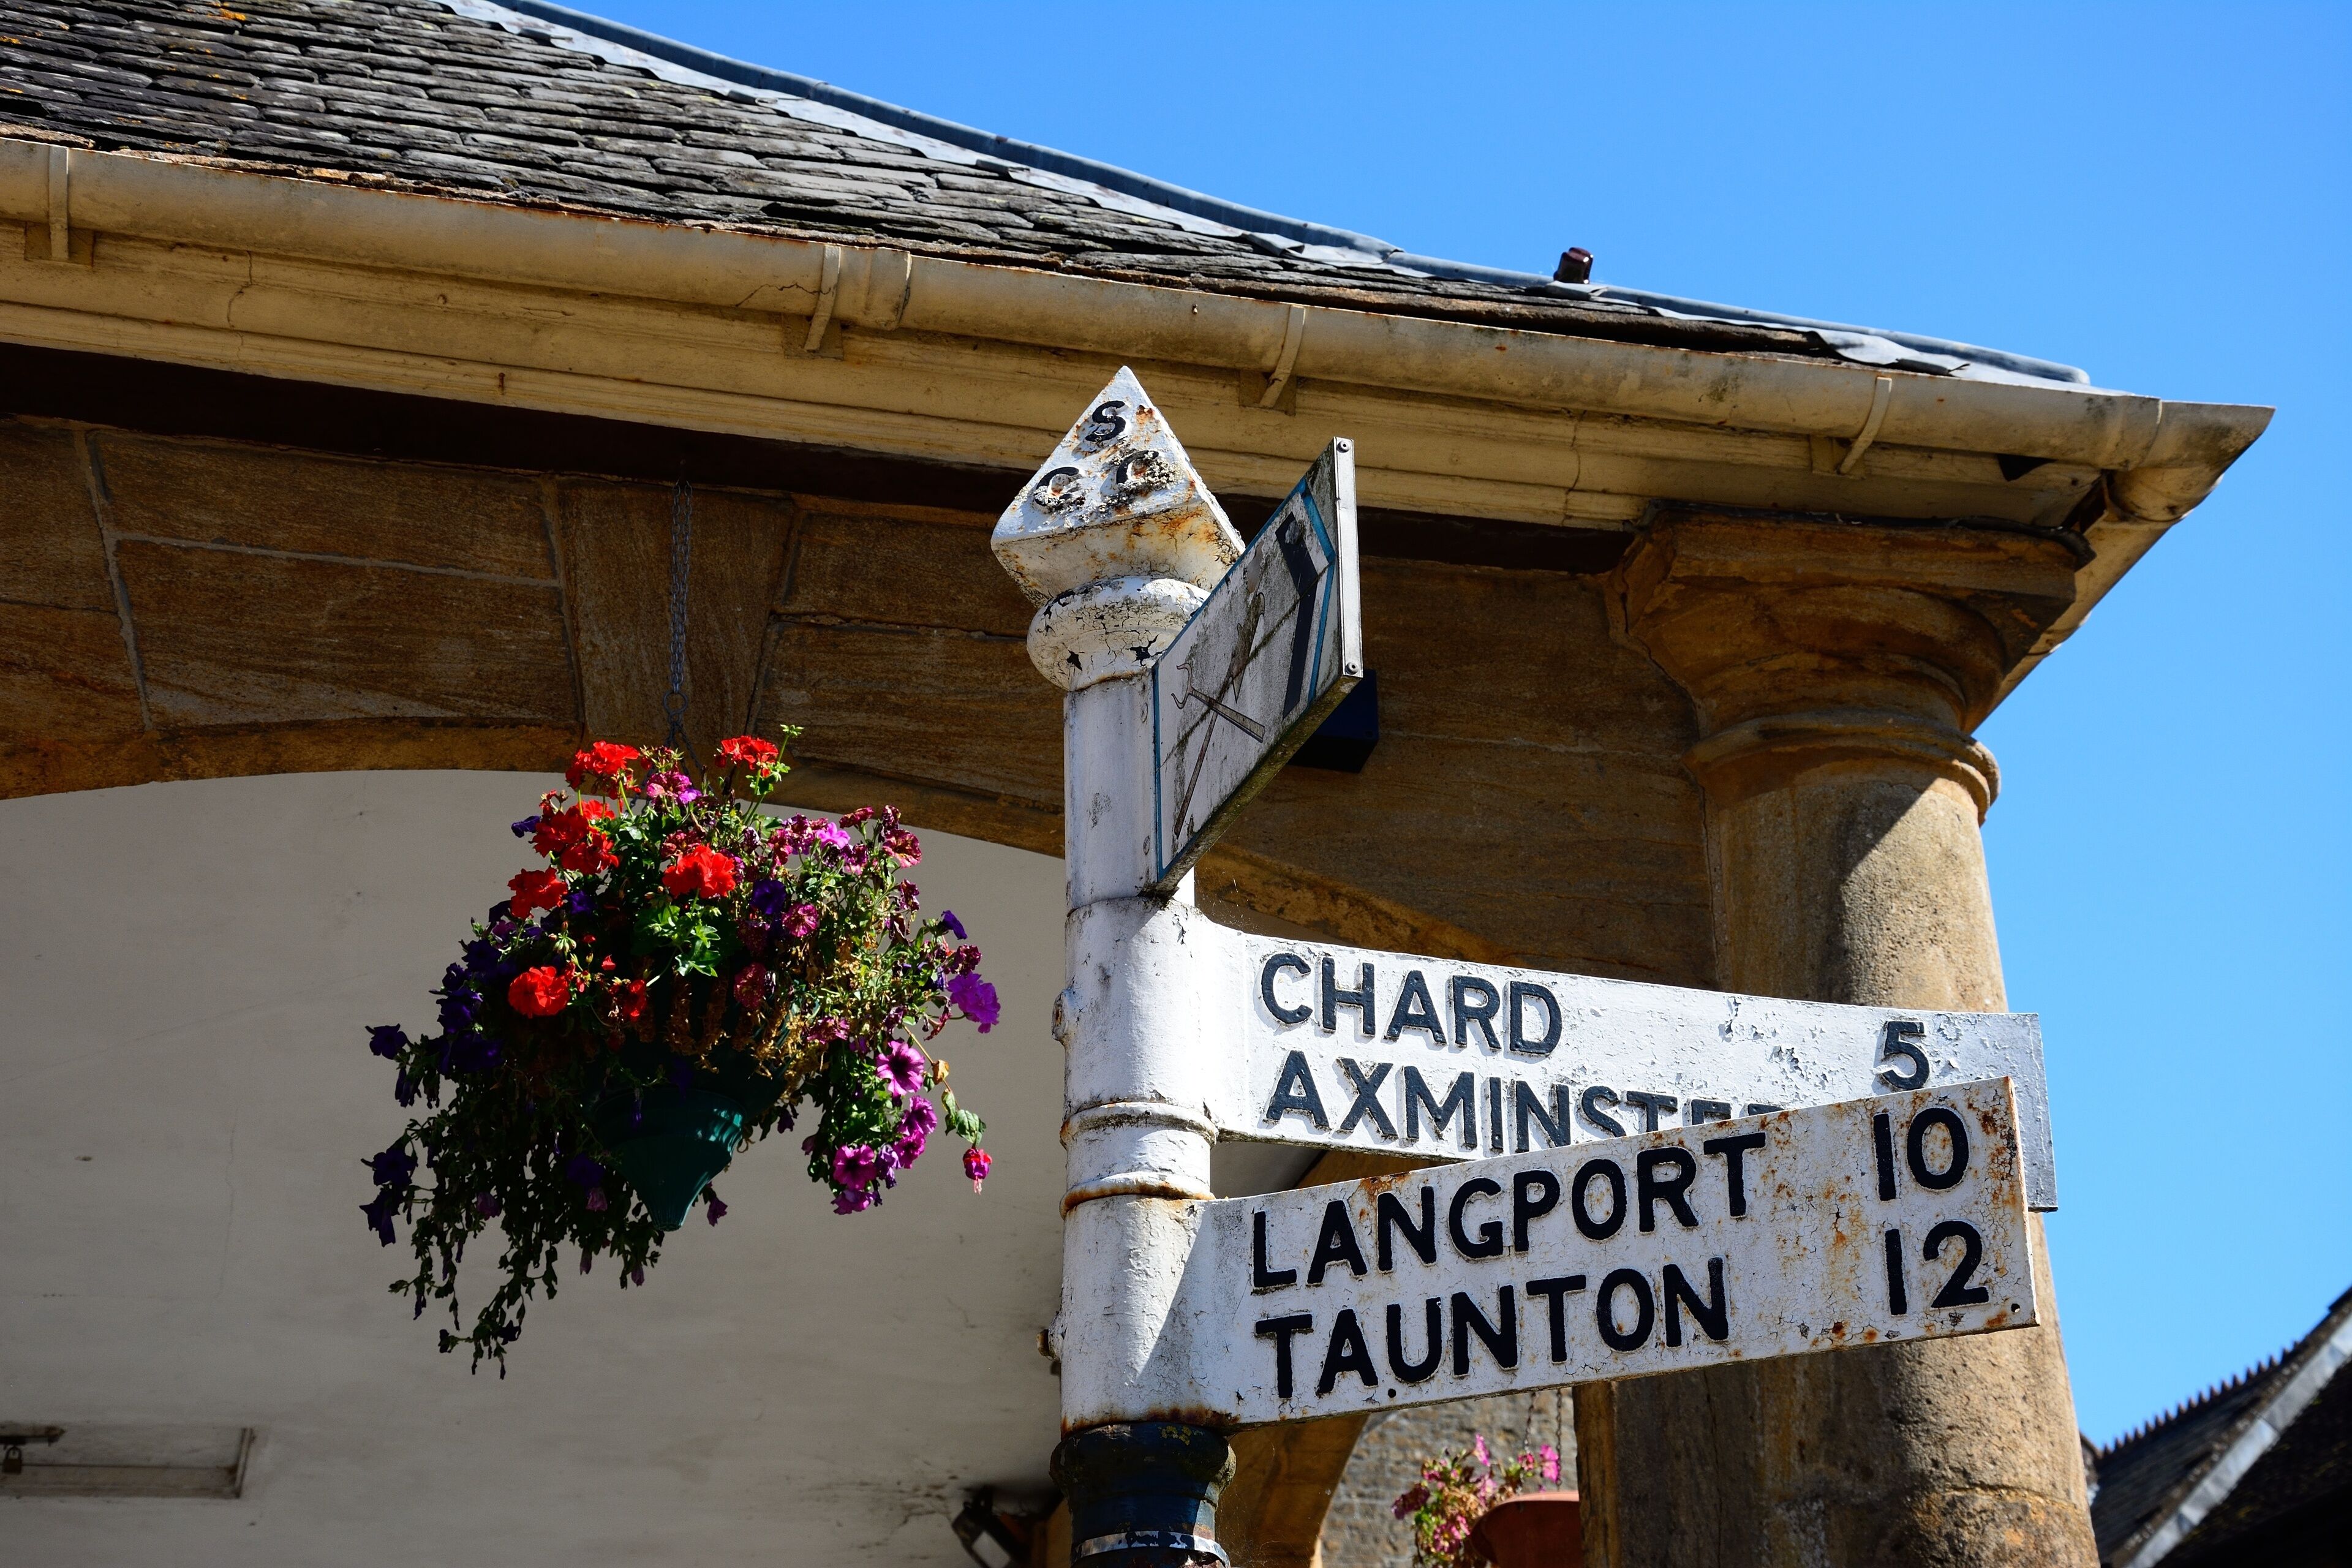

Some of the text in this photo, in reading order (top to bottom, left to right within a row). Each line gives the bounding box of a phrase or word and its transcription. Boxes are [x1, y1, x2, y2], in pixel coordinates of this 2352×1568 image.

[1261, 952, 1930, 1091] CHARD 5
[1265, 1049, 1784, 1153] AXMINST
[1252, 1107, 1969, 1289] LANGPORT 10
[1254, 1219, 1989, 1399] TAUNTON 12
